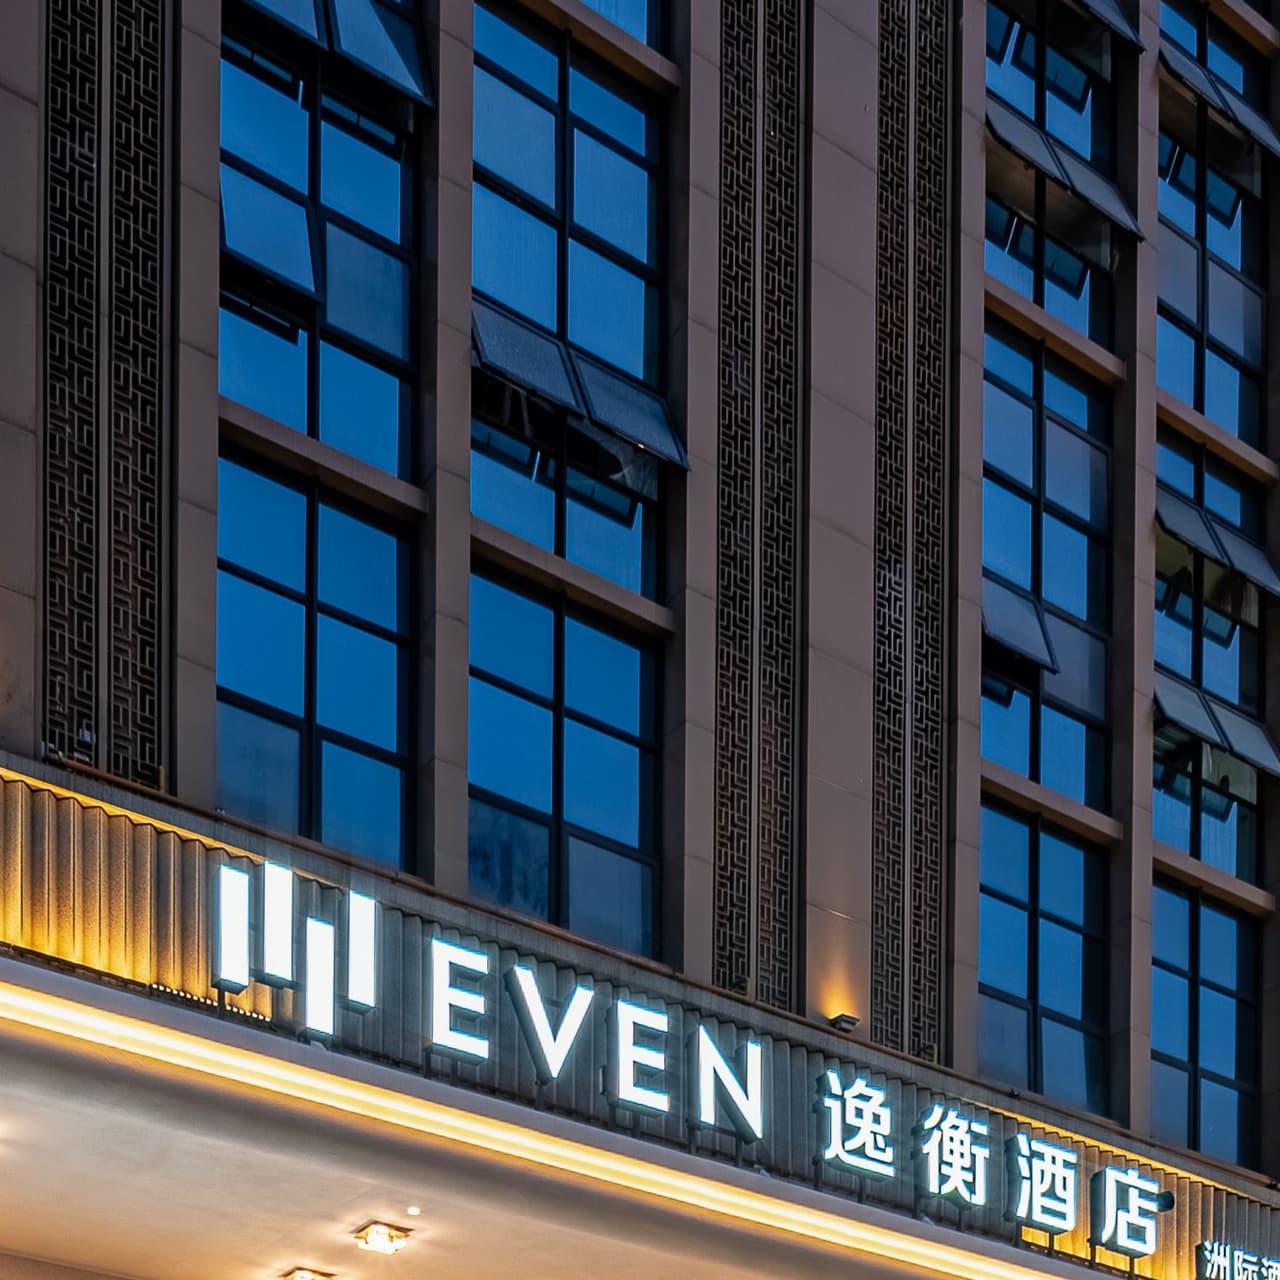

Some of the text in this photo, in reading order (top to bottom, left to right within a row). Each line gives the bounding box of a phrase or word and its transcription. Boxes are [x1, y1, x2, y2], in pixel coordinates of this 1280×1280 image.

[431, 937, 763, 1140] EVEN
[822, 1067, 1162, 1257] 逸衡酒店
